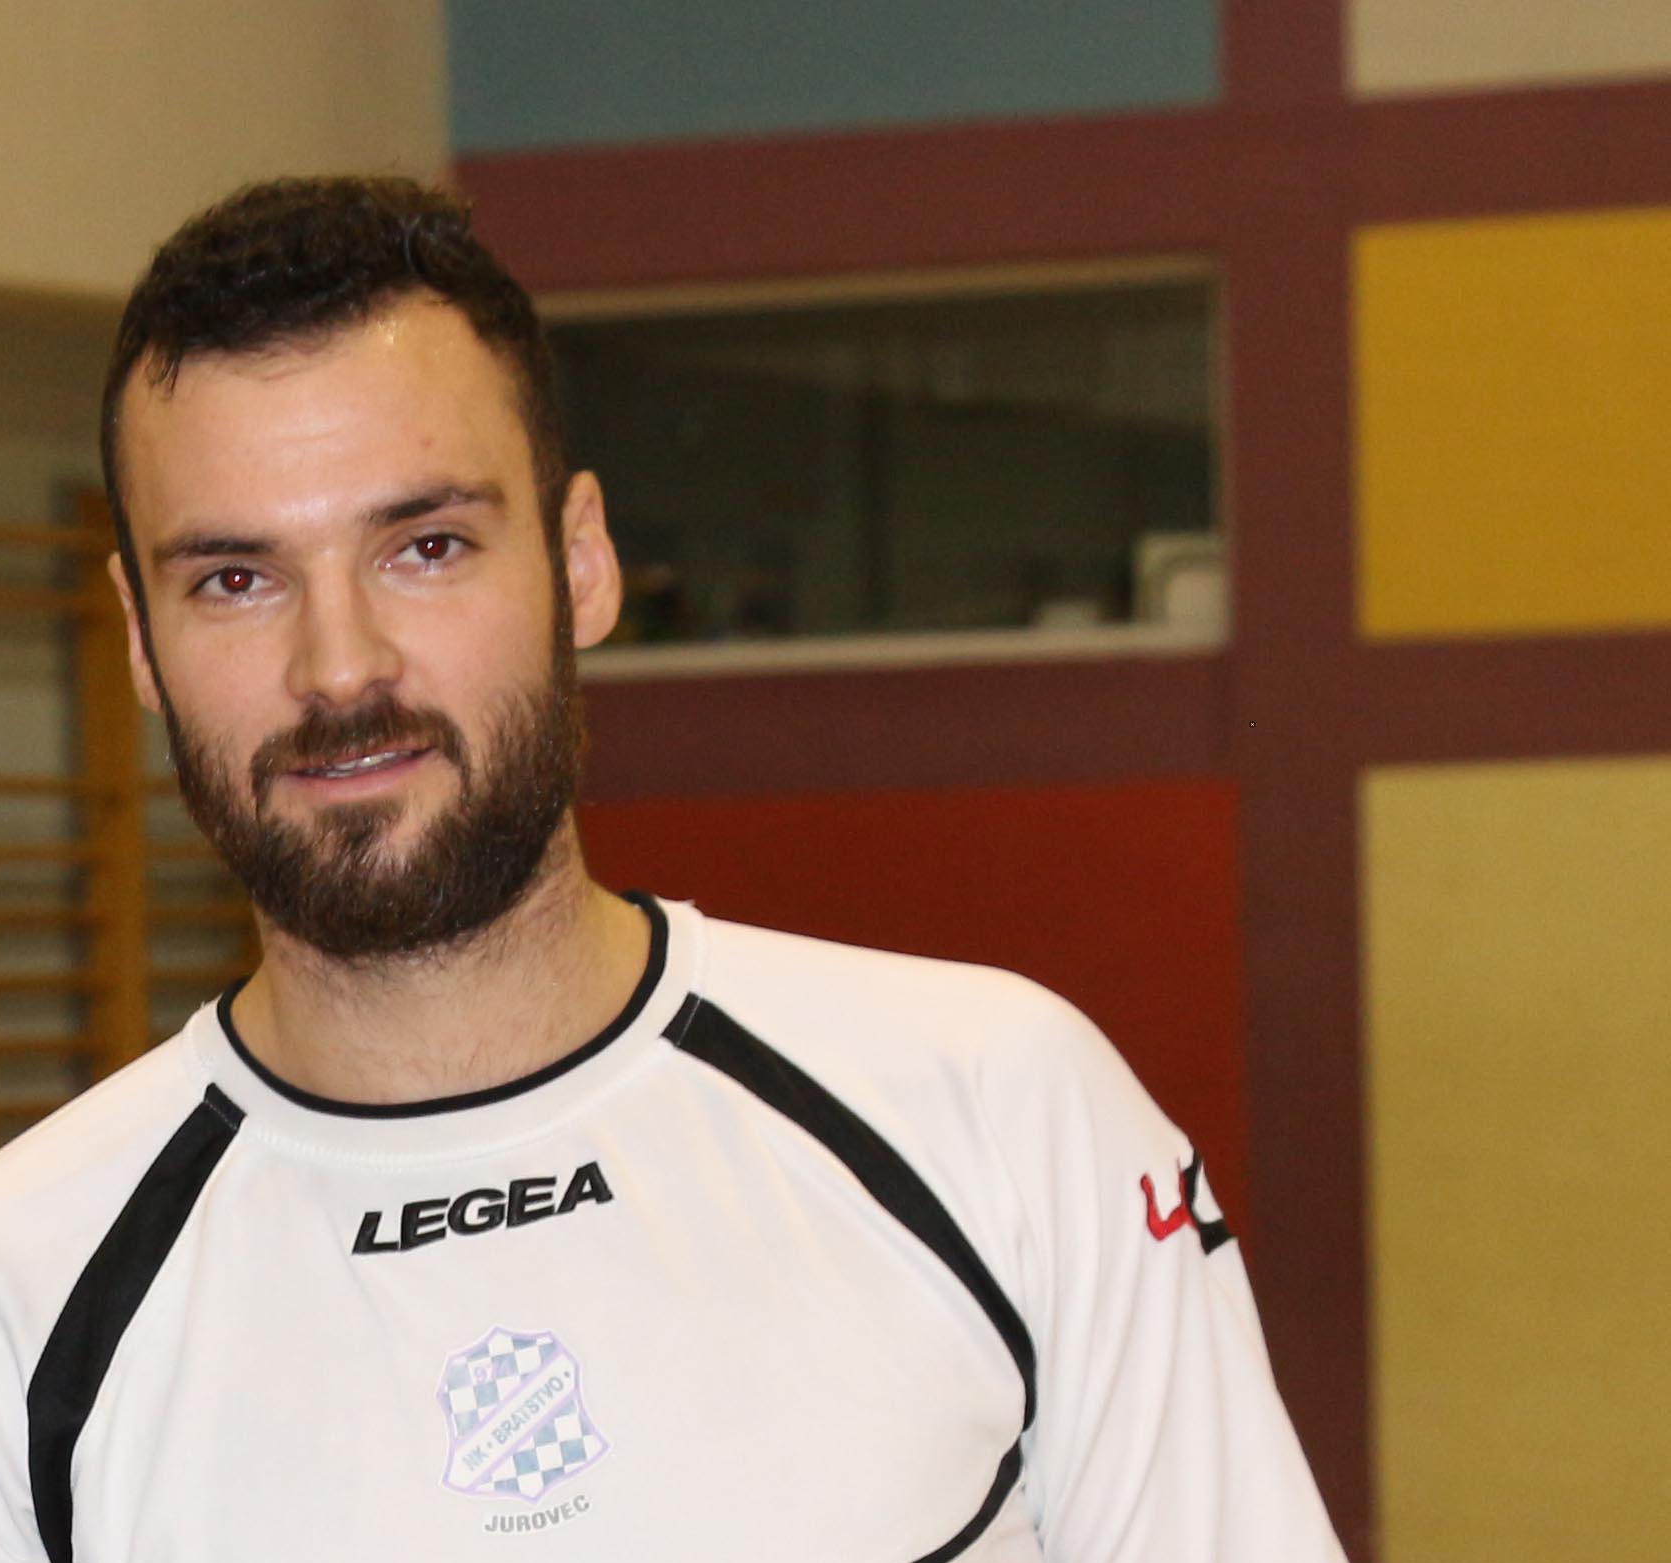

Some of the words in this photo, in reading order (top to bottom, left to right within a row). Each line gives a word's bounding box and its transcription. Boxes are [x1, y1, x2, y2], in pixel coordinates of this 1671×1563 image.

[351, 1161, 614, 1255] LEGEA
[492, 1376, 564, 1445] BRATSTVO
[484, 1494, 590, 1533] JUROVEC
